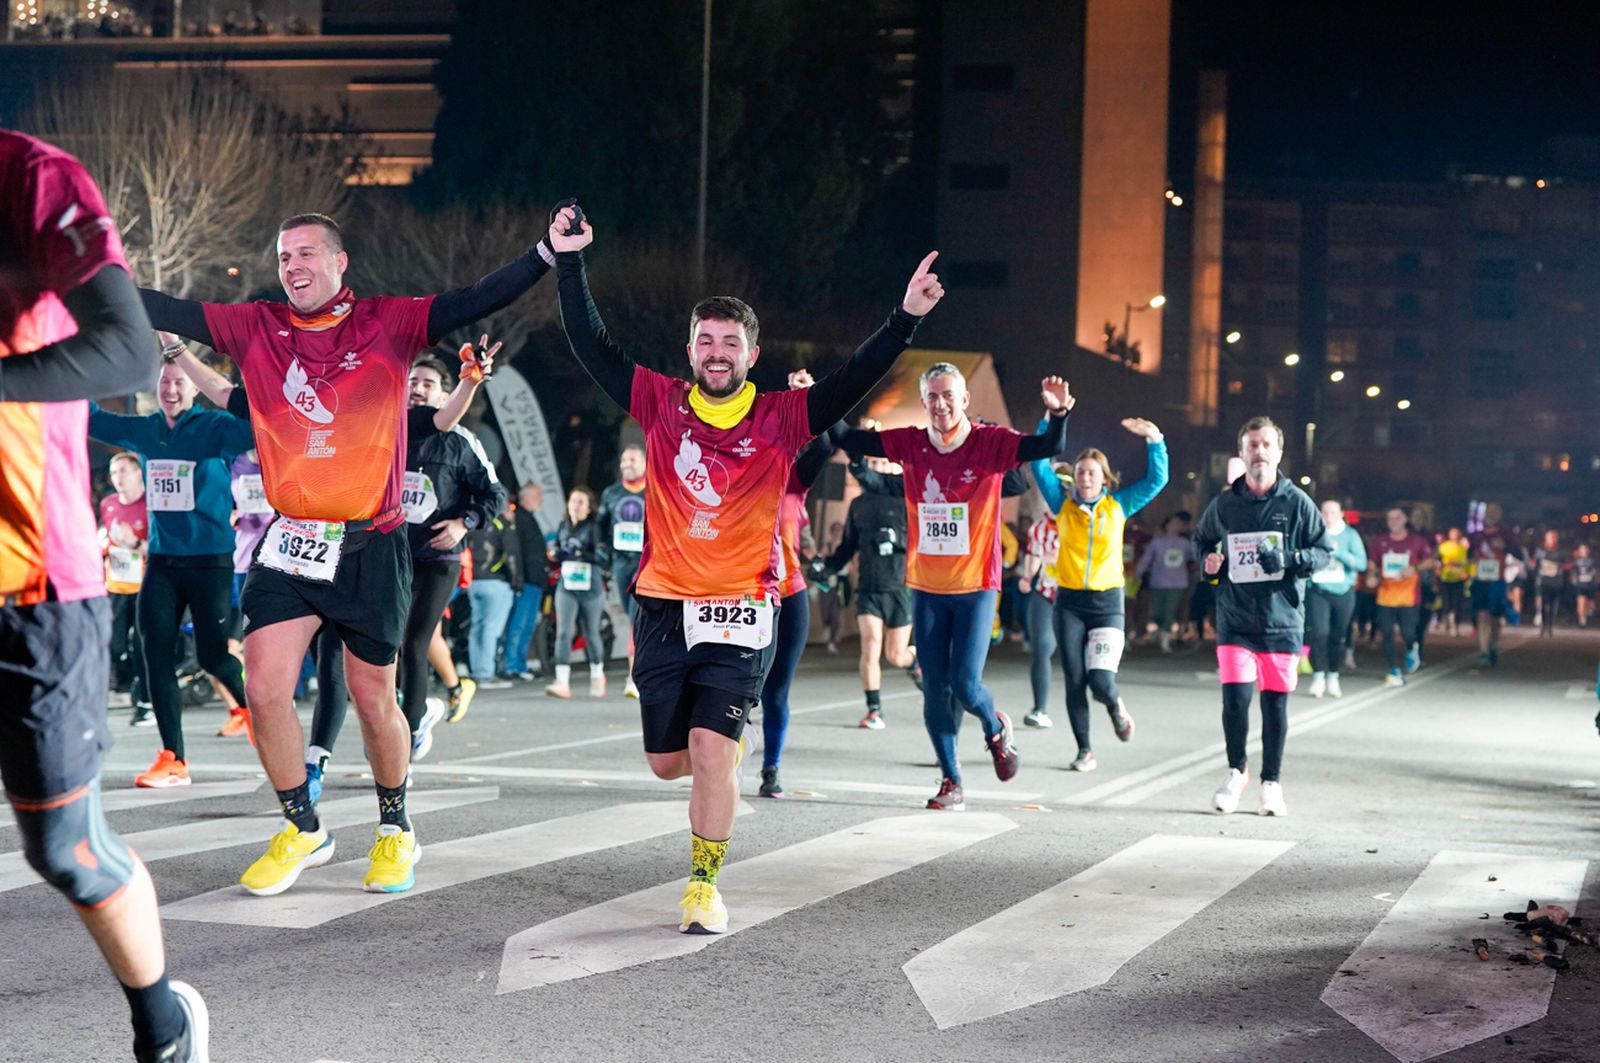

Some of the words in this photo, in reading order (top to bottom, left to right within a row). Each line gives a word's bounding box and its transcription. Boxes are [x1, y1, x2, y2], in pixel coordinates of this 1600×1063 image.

[295, 391, 315, 412] 43
[308, 439, 326, 447] SAN
[154, 478, 180, 493] 5151
[685, 468, 707, 491] 43
[401, 489, 426, 506] 047
[926, 522, 958, 537] 2849
[279, 531, 329, 563] 3922
[694, 599, 712, 607] SAN
[699, 605, 757, 626] 3923
